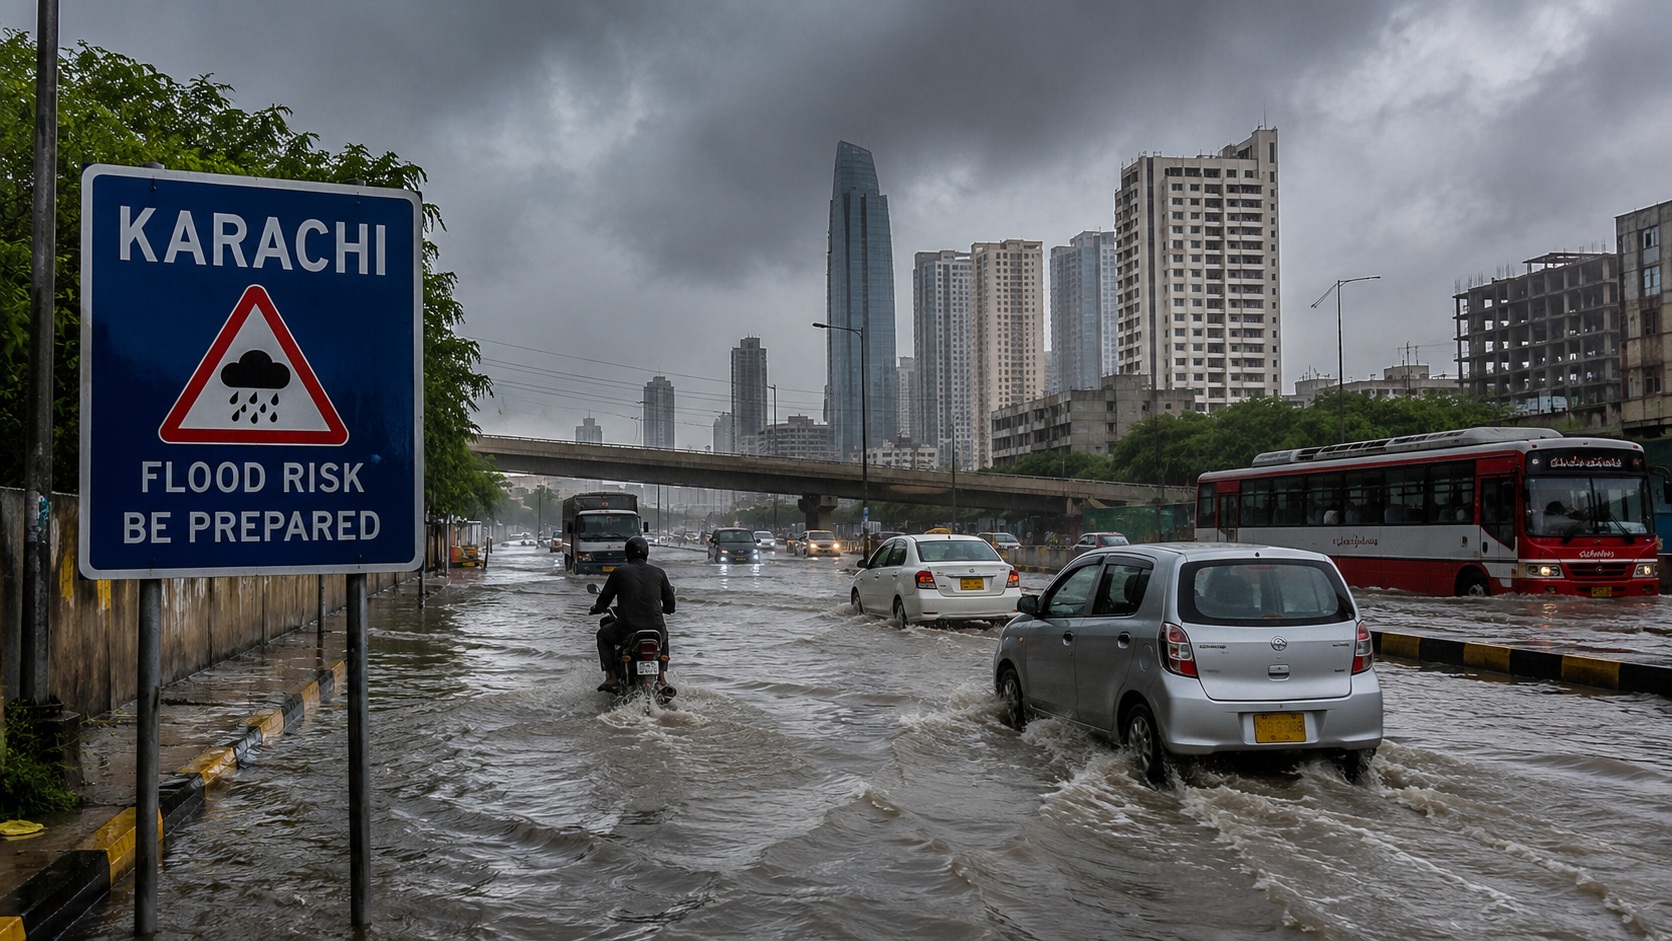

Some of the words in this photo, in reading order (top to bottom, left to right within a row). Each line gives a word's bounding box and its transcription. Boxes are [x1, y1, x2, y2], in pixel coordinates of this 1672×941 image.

[119, 206, 386, 275] KARACHI
[142, 461, 266, 493] FLOOD
[284, 462, 365, 493] RISK
[124, 512, 171, 544] BE
[190, 511, 380, 543] PREPARED
